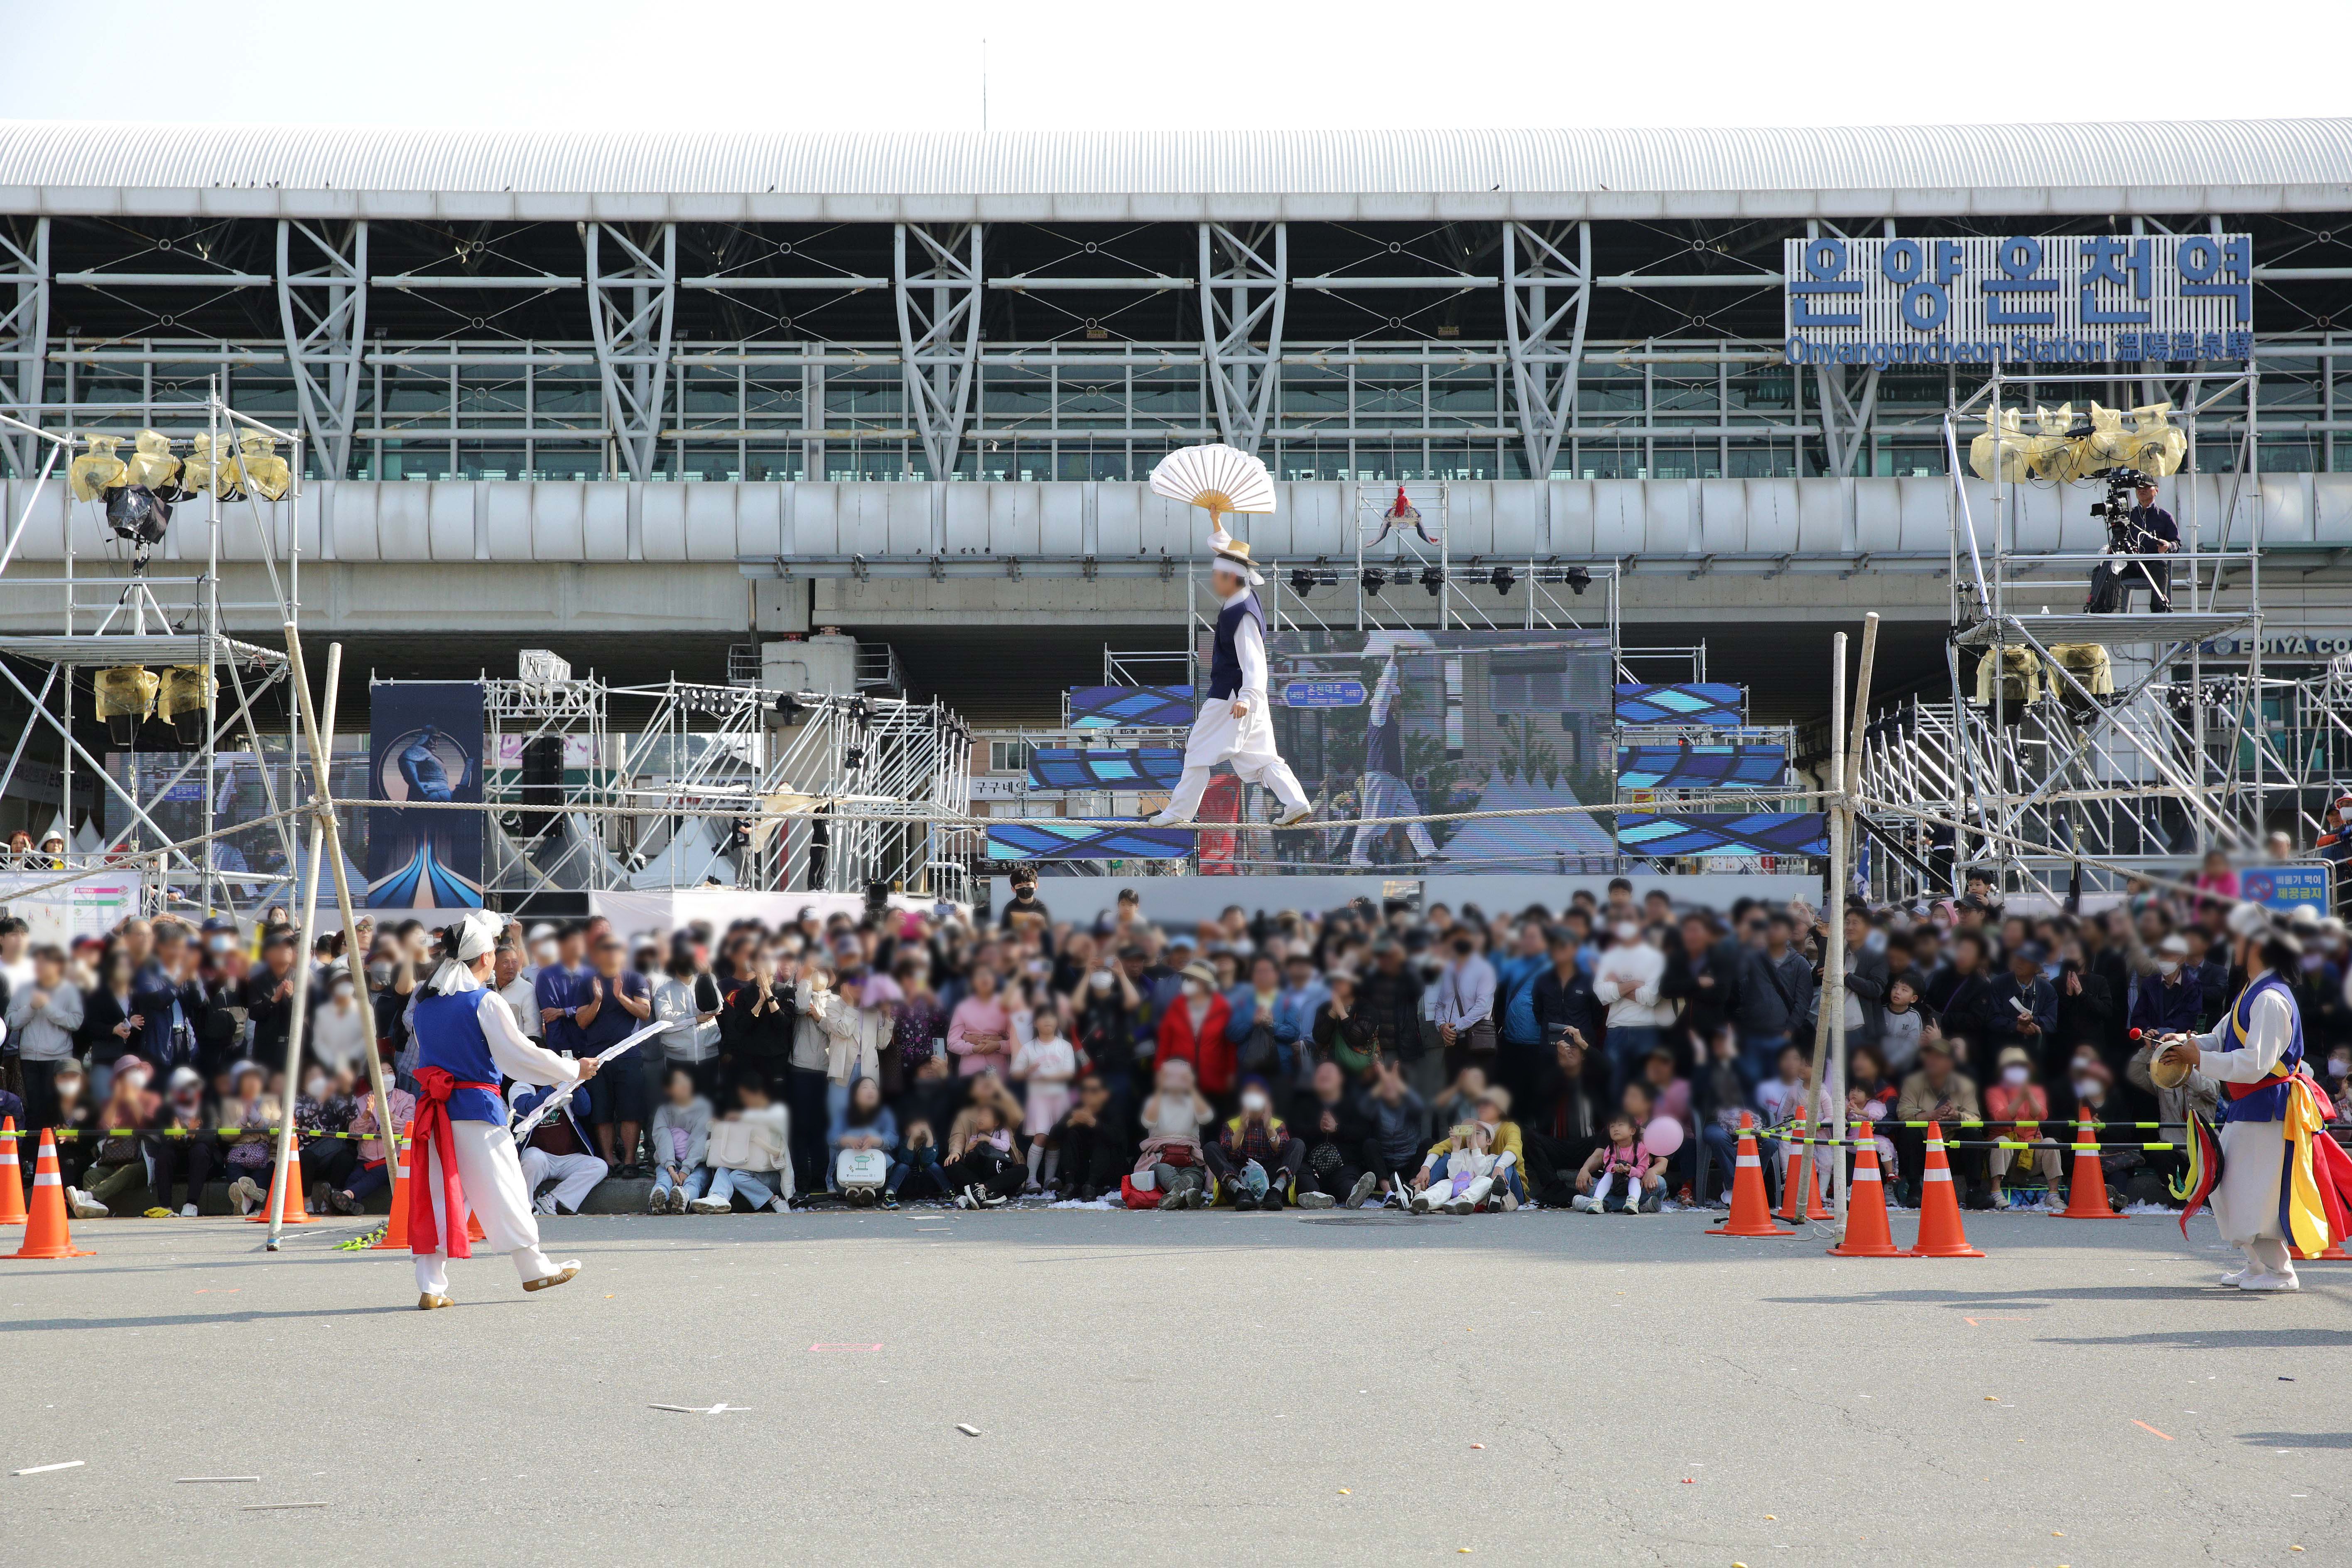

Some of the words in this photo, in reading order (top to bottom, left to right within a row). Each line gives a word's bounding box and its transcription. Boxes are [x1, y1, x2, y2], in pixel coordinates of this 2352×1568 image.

[1790, 236, 2250, 331] 온양온천역
[1786, 334, 2006, 371] Onyangoncheon
[2011, 333, 2105, 363] Station
[2239, 638, 2309, 655] EDIYA
[2276, 875, 2301, 884] 비둘기
[2305, 875, 2321, 884] 먹이
[2277, 887, 2322, 899] 제공금지
